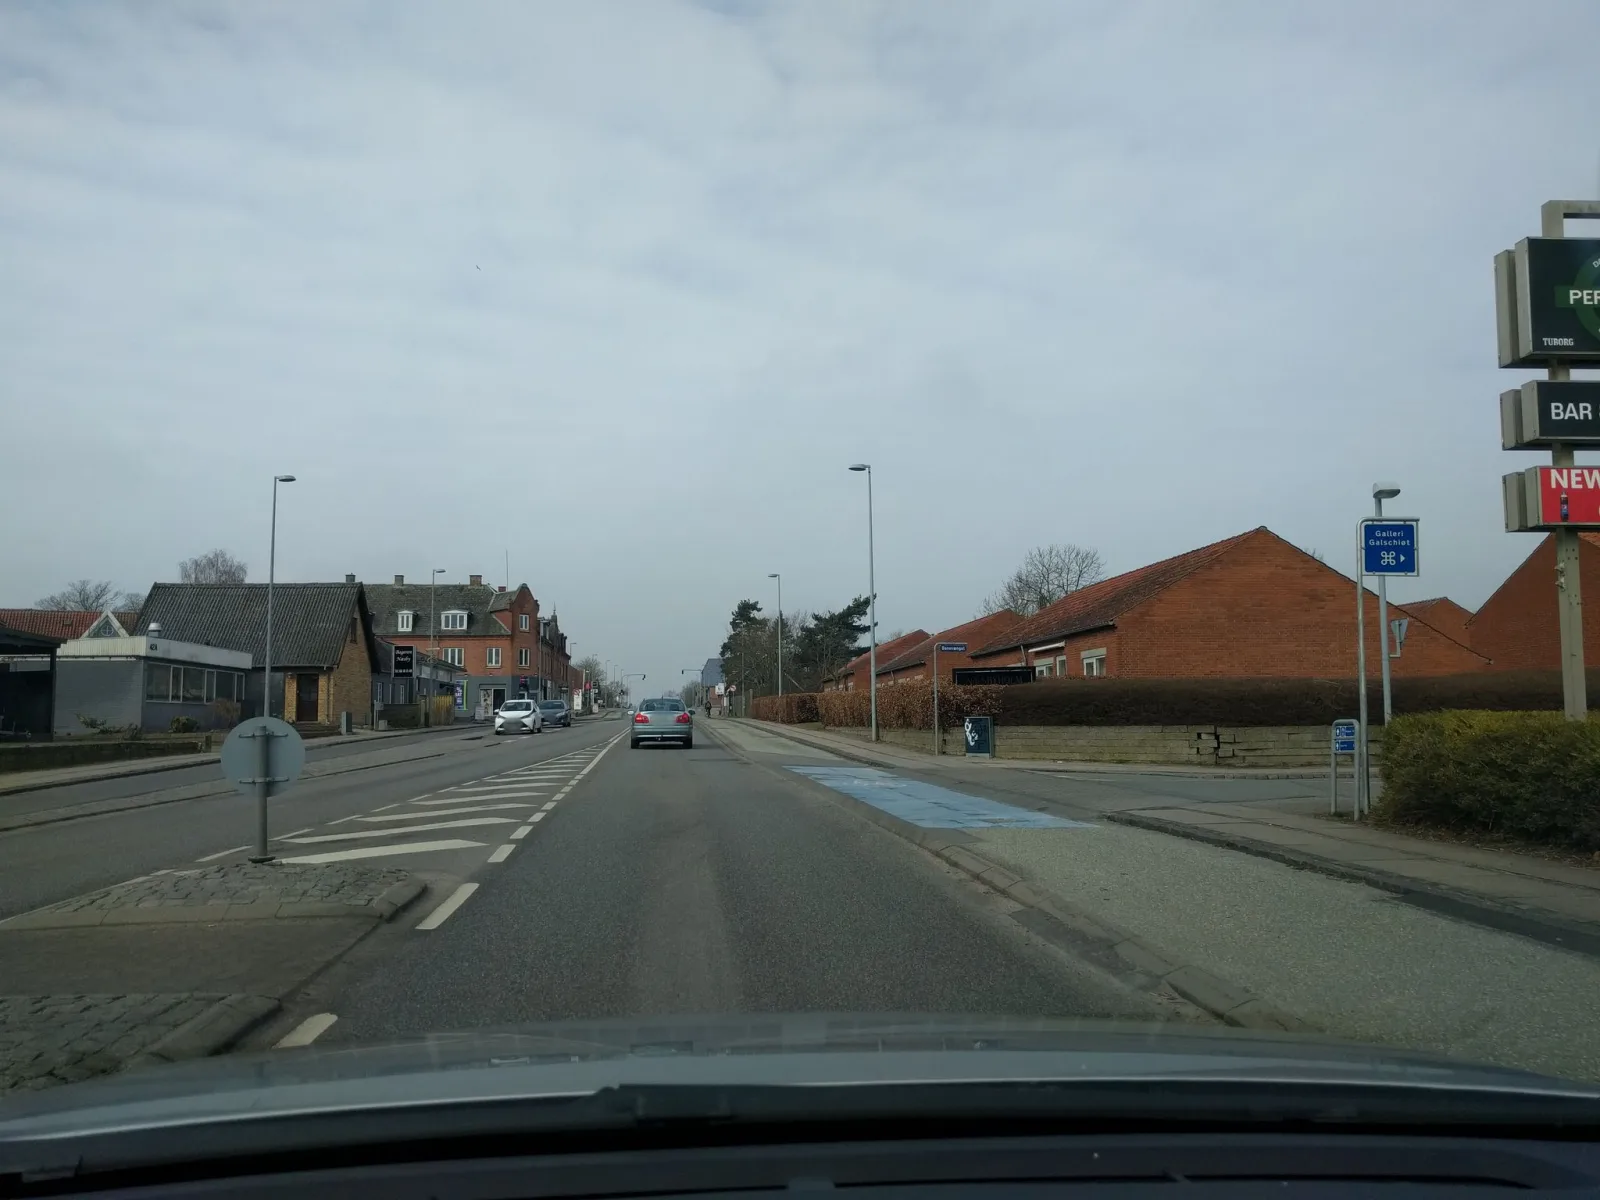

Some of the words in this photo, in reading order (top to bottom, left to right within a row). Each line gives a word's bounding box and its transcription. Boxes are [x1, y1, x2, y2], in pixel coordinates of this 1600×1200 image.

[1542, 337, 1574, 346] TUBORG
[1550, 402, 1593, 420] BAR
[1550, 469, 1600, 489] NEW
